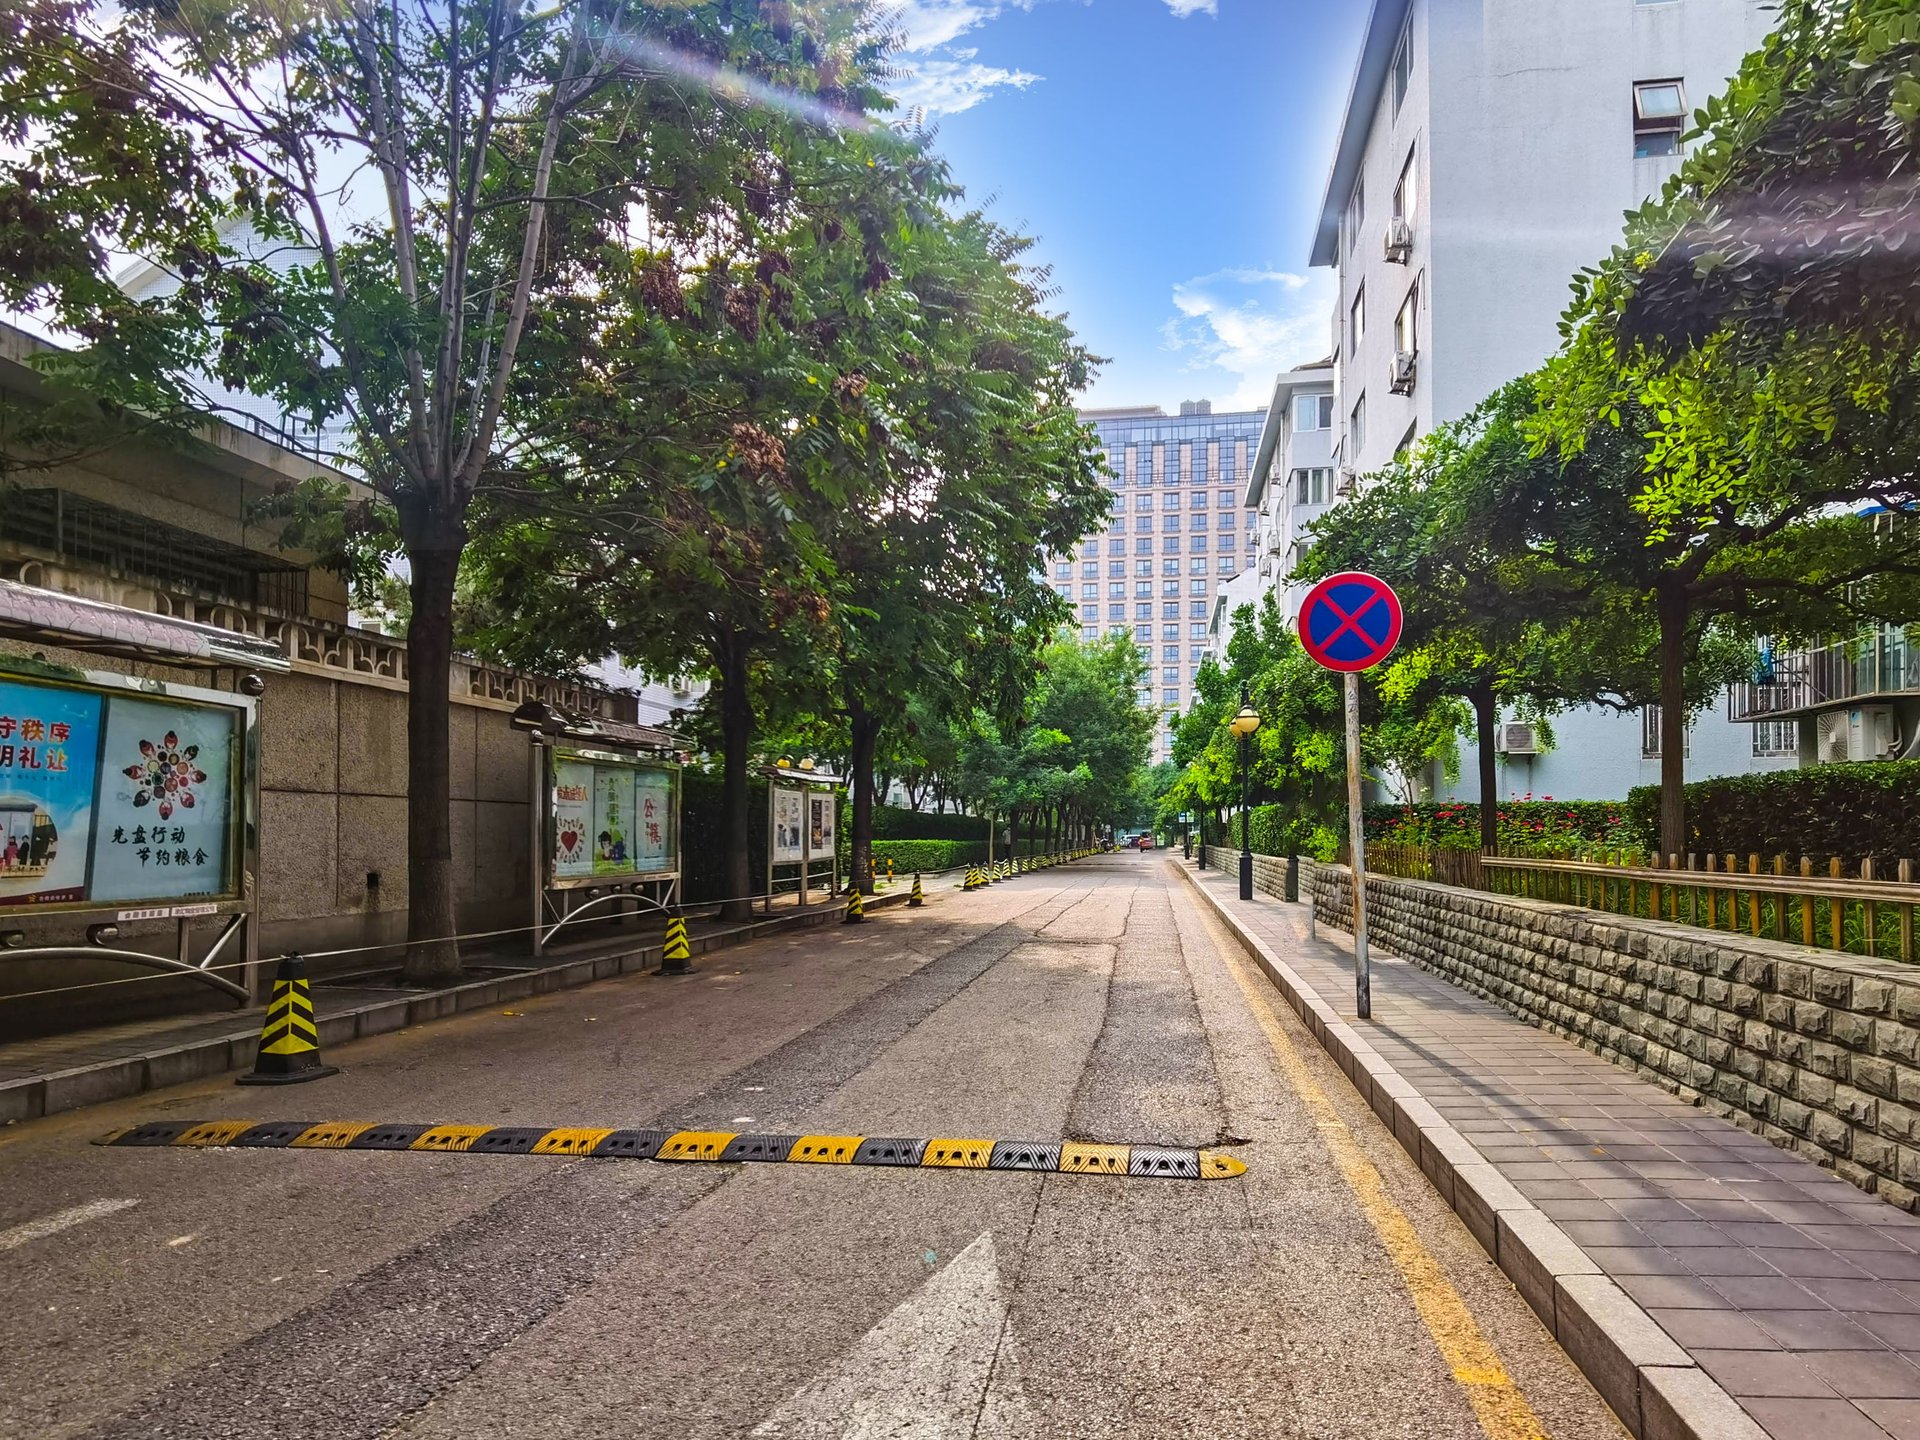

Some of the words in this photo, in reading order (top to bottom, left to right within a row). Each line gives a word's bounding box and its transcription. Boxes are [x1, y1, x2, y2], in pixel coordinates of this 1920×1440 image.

[111, 824, 186, 845] 光盘行动
[135, 846, 210, 869] 节约粮食
